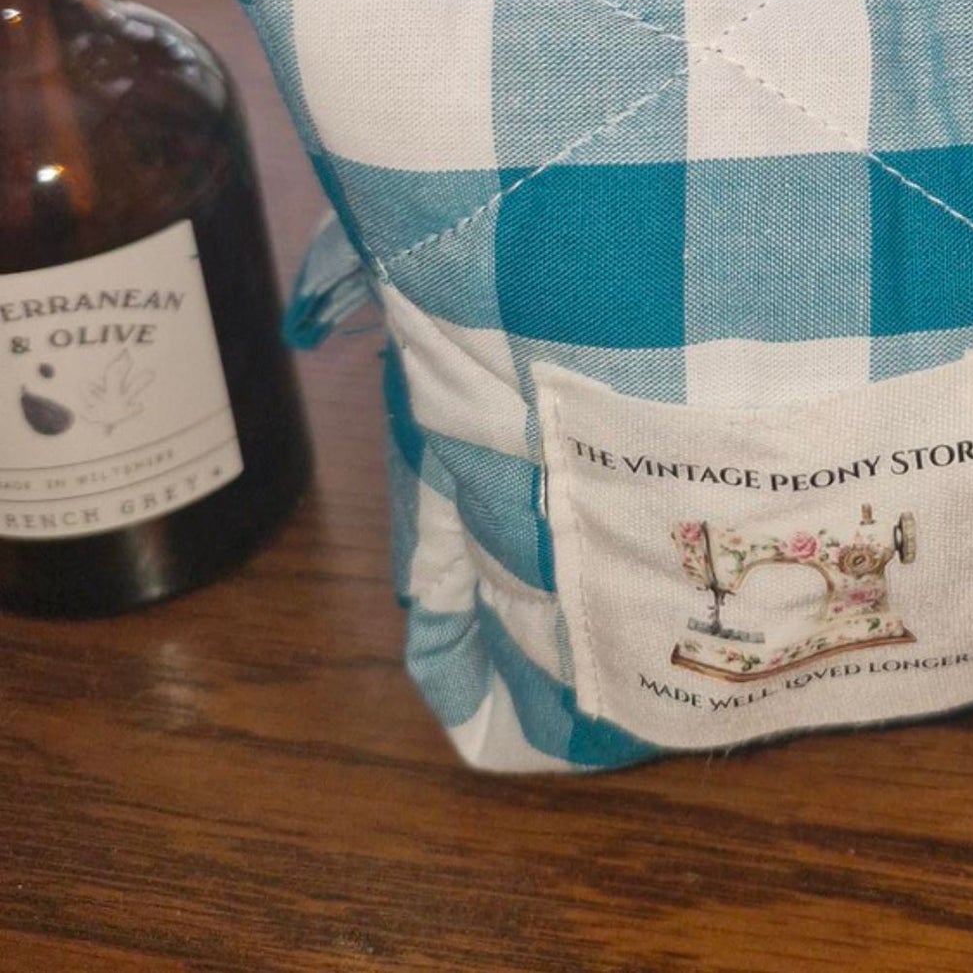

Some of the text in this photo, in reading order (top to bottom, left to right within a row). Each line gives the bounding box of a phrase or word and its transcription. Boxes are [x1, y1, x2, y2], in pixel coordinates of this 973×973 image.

[0, 289, 185, 322] ERRANEAN
[10, 324, 157, 355] & OLIVE
[568, 437, 617, 470] THE
[622, 454, 761, 489] VINTAGE
[769, 455, 881, 492] PEONY
[5, 474, 198, 528] RENCH GREY
[639, 653, 970, 711] MADE WELL LOVED LONGER
